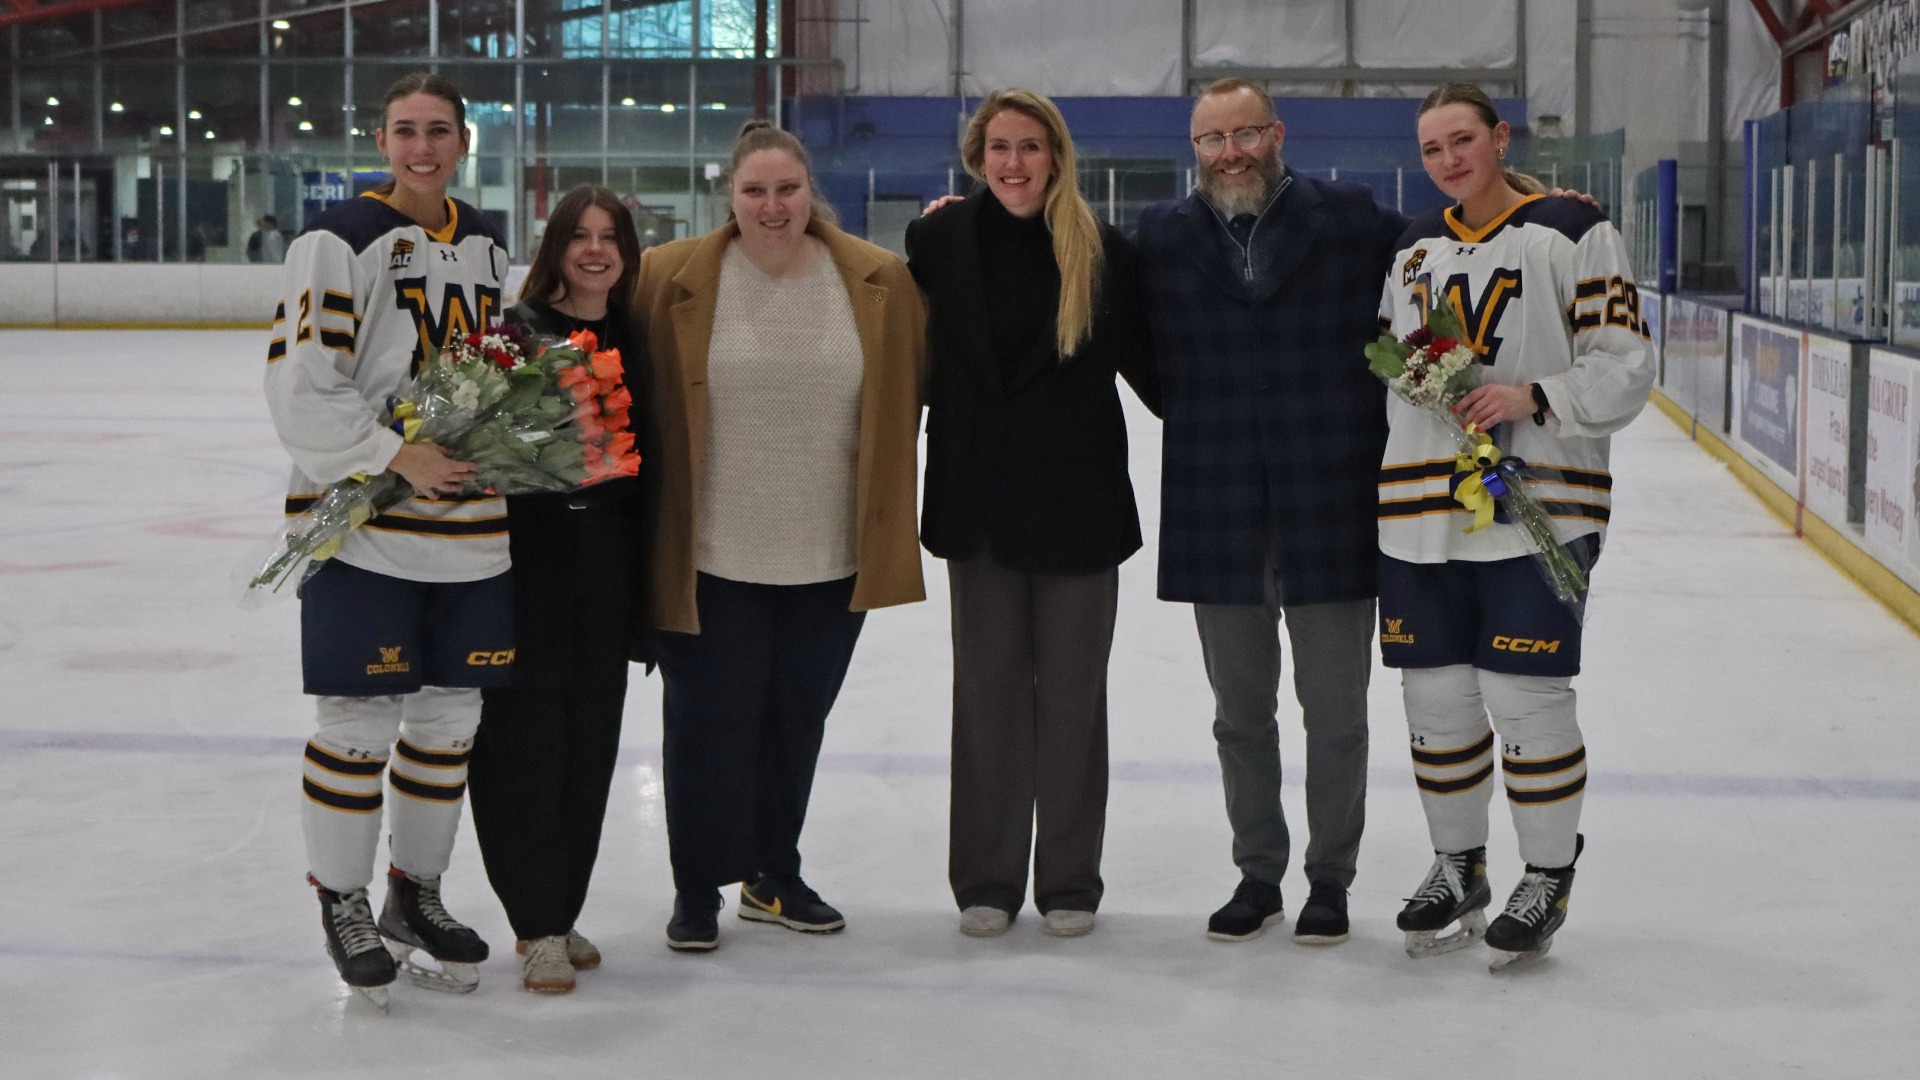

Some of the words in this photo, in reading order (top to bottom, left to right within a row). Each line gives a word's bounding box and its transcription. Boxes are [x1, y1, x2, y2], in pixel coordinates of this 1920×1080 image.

[296, 288, 313, 346] 2
[395, 276, 501, 381] W
[1408, 267, 1523, 366] W
[1604, 274, 1641, 334] 29
[379, 646, 402, 663] W
[1385, 618, 1402, 633] W
[1492, 635, 1561, 653] CCM
